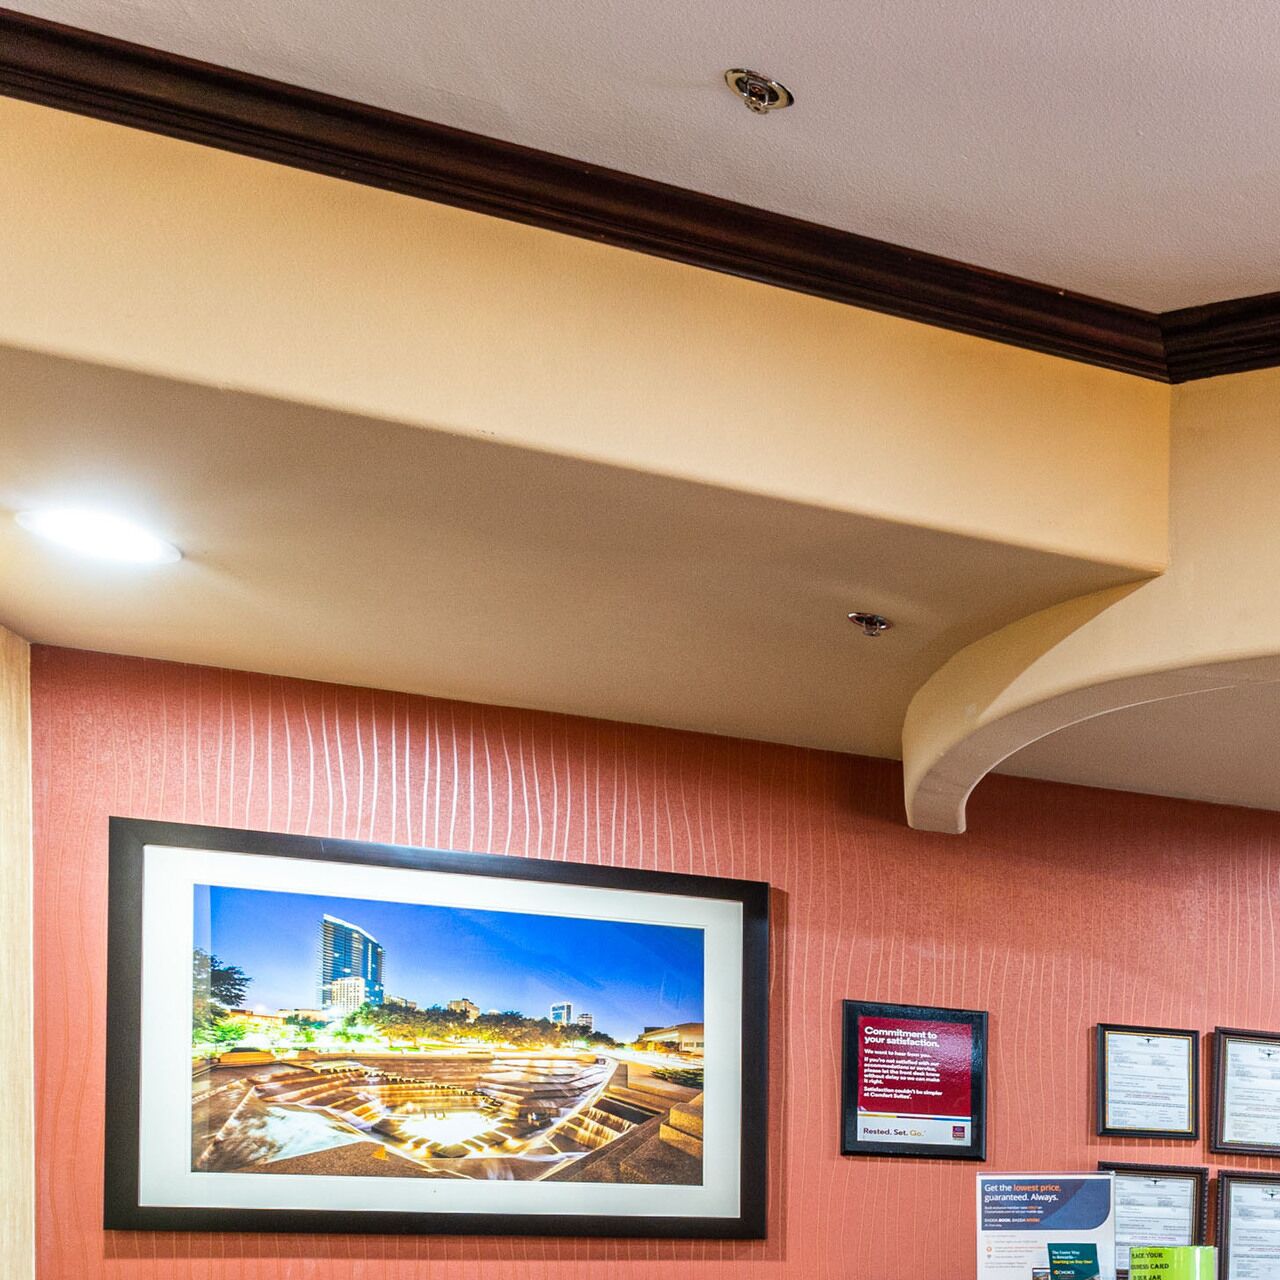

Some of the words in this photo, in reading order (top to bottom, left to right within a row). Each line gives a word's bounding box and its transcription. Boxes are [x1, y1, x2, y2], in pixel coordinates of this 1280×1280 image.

[864, 1026, 926, 1038] Commitment
[864, 1036, 885, 1044] your
[886, 1037, 940, 1048] satisfaction.
[863, 1127, 892, 1135] Rested.
[894, 1128, 908, 1136] Set.
[985, 1184, 998, 1192] Get
[999, 1184, 1012, 1192] the
[1013, 1184, 1039, 1192] lowest
[984, 1193, 1029, 1203] guaranteed.
[1030, 1193, 1059, 1203] Always.
